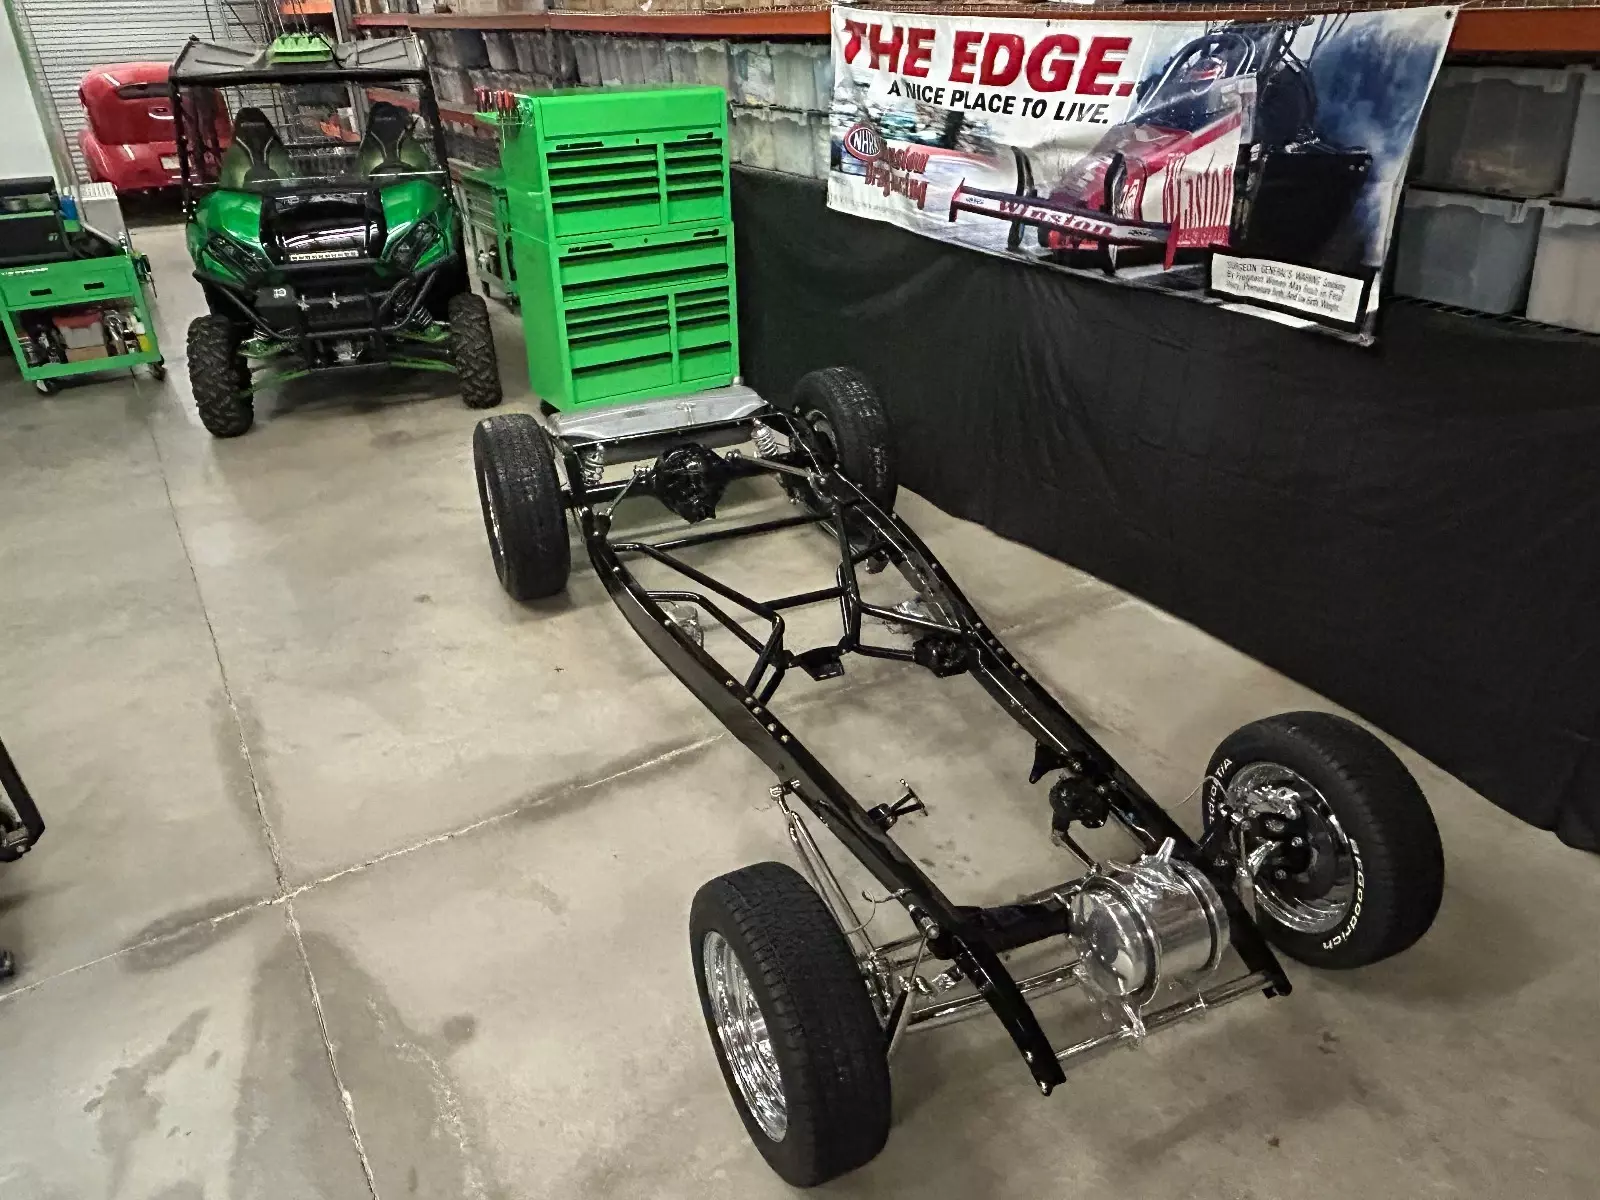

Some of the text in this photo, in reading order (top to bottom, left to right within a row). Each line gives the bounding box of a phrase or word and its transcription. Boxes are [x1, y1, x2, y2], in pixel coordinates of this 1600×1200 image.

[844, 19, 1138, 97] THE EDGE.
[887, 79, 1110, 124] A NICE PLACE TO LIVE.
[1215, 758, 1233, 778] T/A
